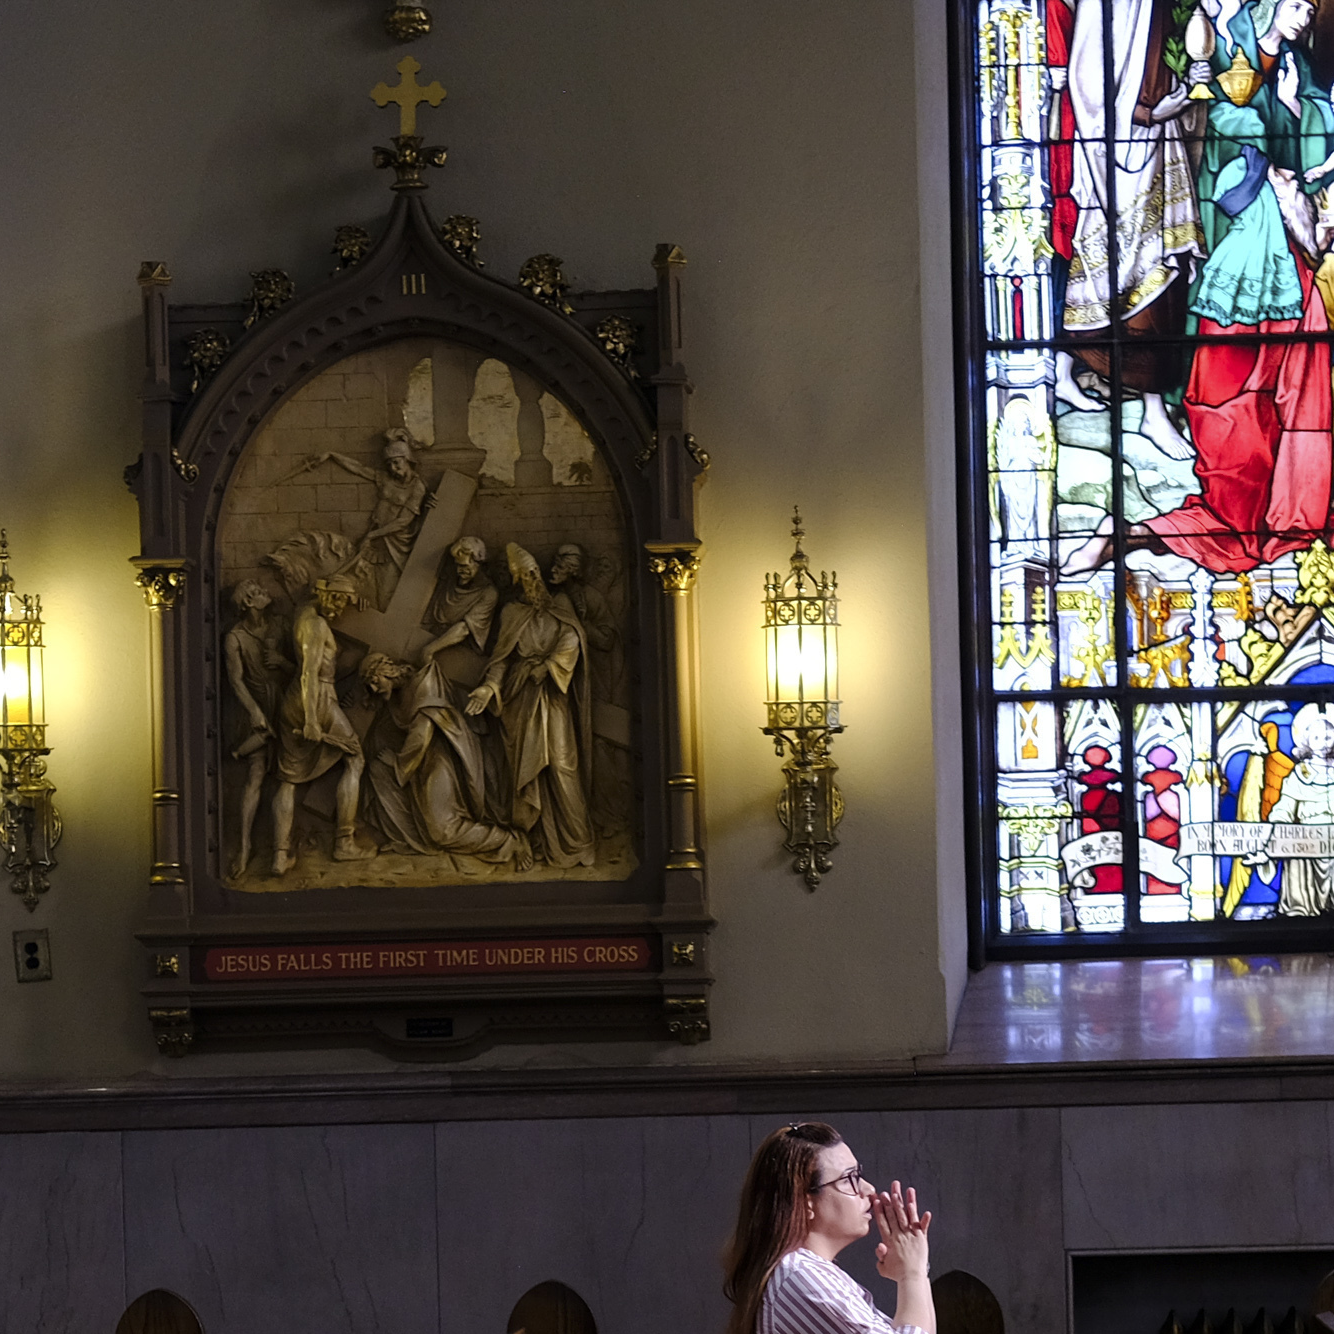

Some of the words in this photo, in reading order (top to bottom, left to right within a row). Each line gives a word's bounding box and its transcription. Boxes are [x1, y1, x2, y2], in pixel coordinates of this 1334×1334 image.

[402, 273, 427, 295] III
[1203, 824, 1245, 838] MMORY
[1249, 825, 1264, 838] OF
[217, 955, 271, 973] JESUS
[278, 954, 332, 971] FALLS
[338, 953, 372, 969] THE
[380, 951, 427, 968] FIRST
[435, 950, 478, 966] TIME
[486, 948, 544, 965] UNDER
[552, 947, 578, 964] HIS
[584, 946, 638, 963] CROSS
